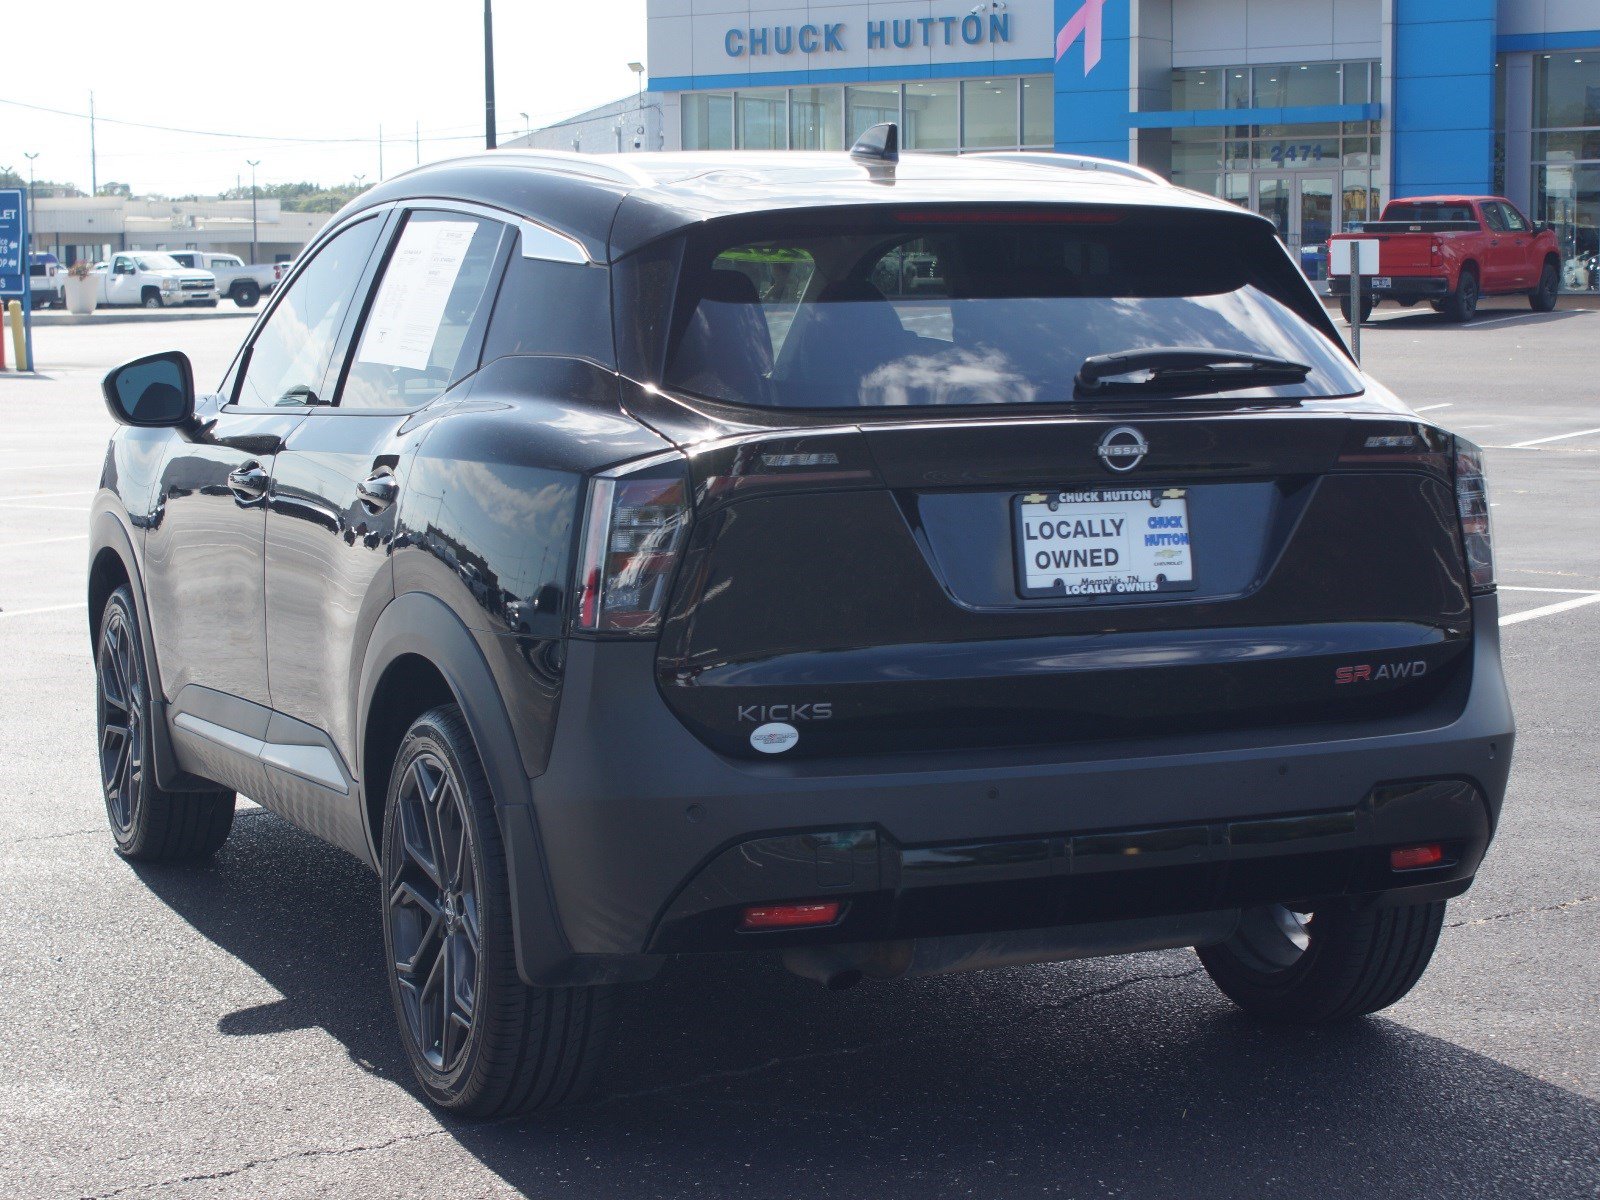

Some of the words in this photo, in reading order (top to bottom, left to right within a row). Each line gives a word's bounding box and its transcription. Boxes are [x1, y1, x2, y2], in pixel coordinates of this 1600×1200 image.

[725, 23, 846, 57] CHUCK
[867, 13, 1009, 49] HUTTON
[1270, 144, 1322, 162] 2471
[1099, 446, 1147, 456] NISSAN
[1059, 491, 1099, 502] CHUCK
[1103, 490, 1151, 501] HUTTON
[1025, 518, 1124, 540] LOCALLY
[1147, 516, 1183, 529] CHUCK
[1144, 533, 1189, 546] HUTTON
[1035, 547, 1119, 570] OWNED
[1065, 583, 1112, 594] LOCALLY
[1115, 582, 1158, 592] OWNED
[1335, 664, 1371, 684] SR
[1374, 660, 1427, 680] AWD
[737, 702, 833, 721] KICKS
